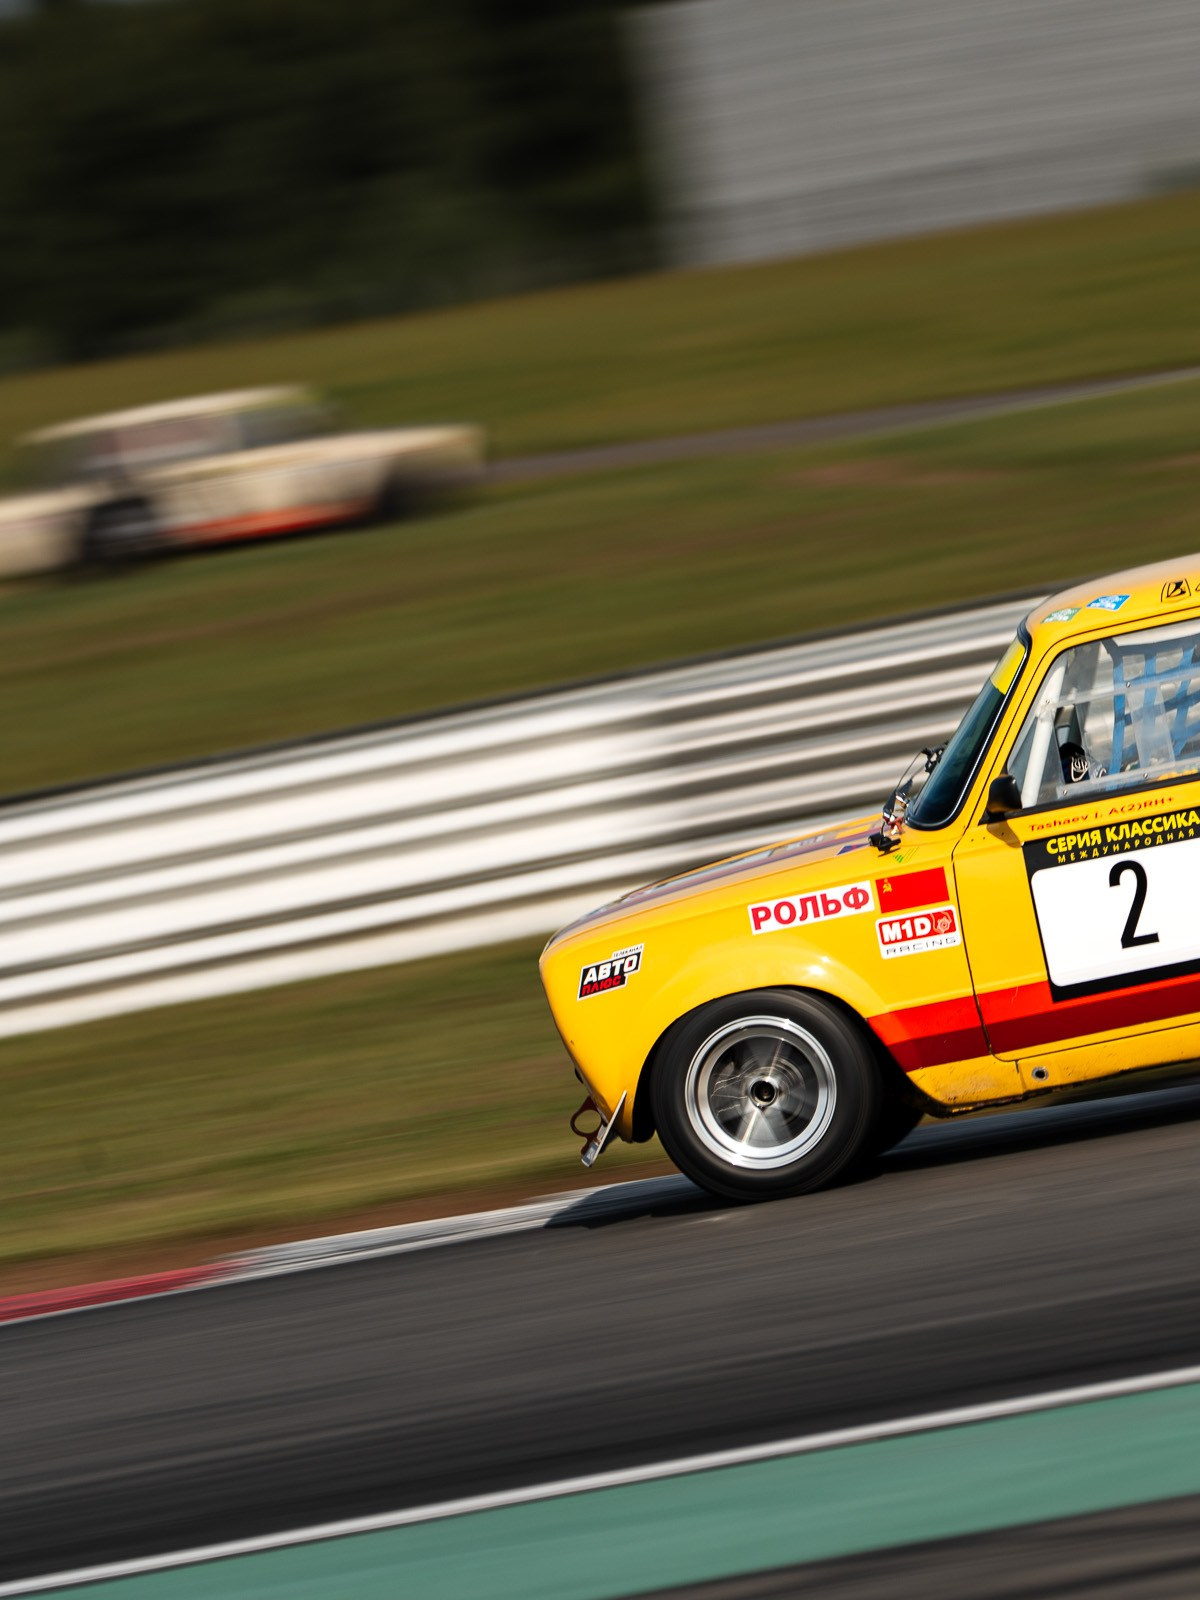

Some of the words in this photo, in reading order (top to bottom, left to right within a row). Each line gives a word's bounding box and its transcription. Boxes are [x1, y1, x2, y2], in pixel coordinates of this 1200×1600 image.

[1028, 813, 1089, 833] Tashaev
[1046, 829, 1102, 855] СЕРИЯ
[1105, 810, 1200, 843] КЛАССИКА
[1057, 827, 1195, 864] МЕЖДУНАРОДНАЯ
[751, 887, 870, 930] РОЛЬФ
[1109, 860, 1160, 949] 2
[881, 917, 932, 943] M1D
[886, 937, 957, 955] RACING
[581, 975, 622, 996] ПЛЮС
[583, 954, 638, 986] АВТО
